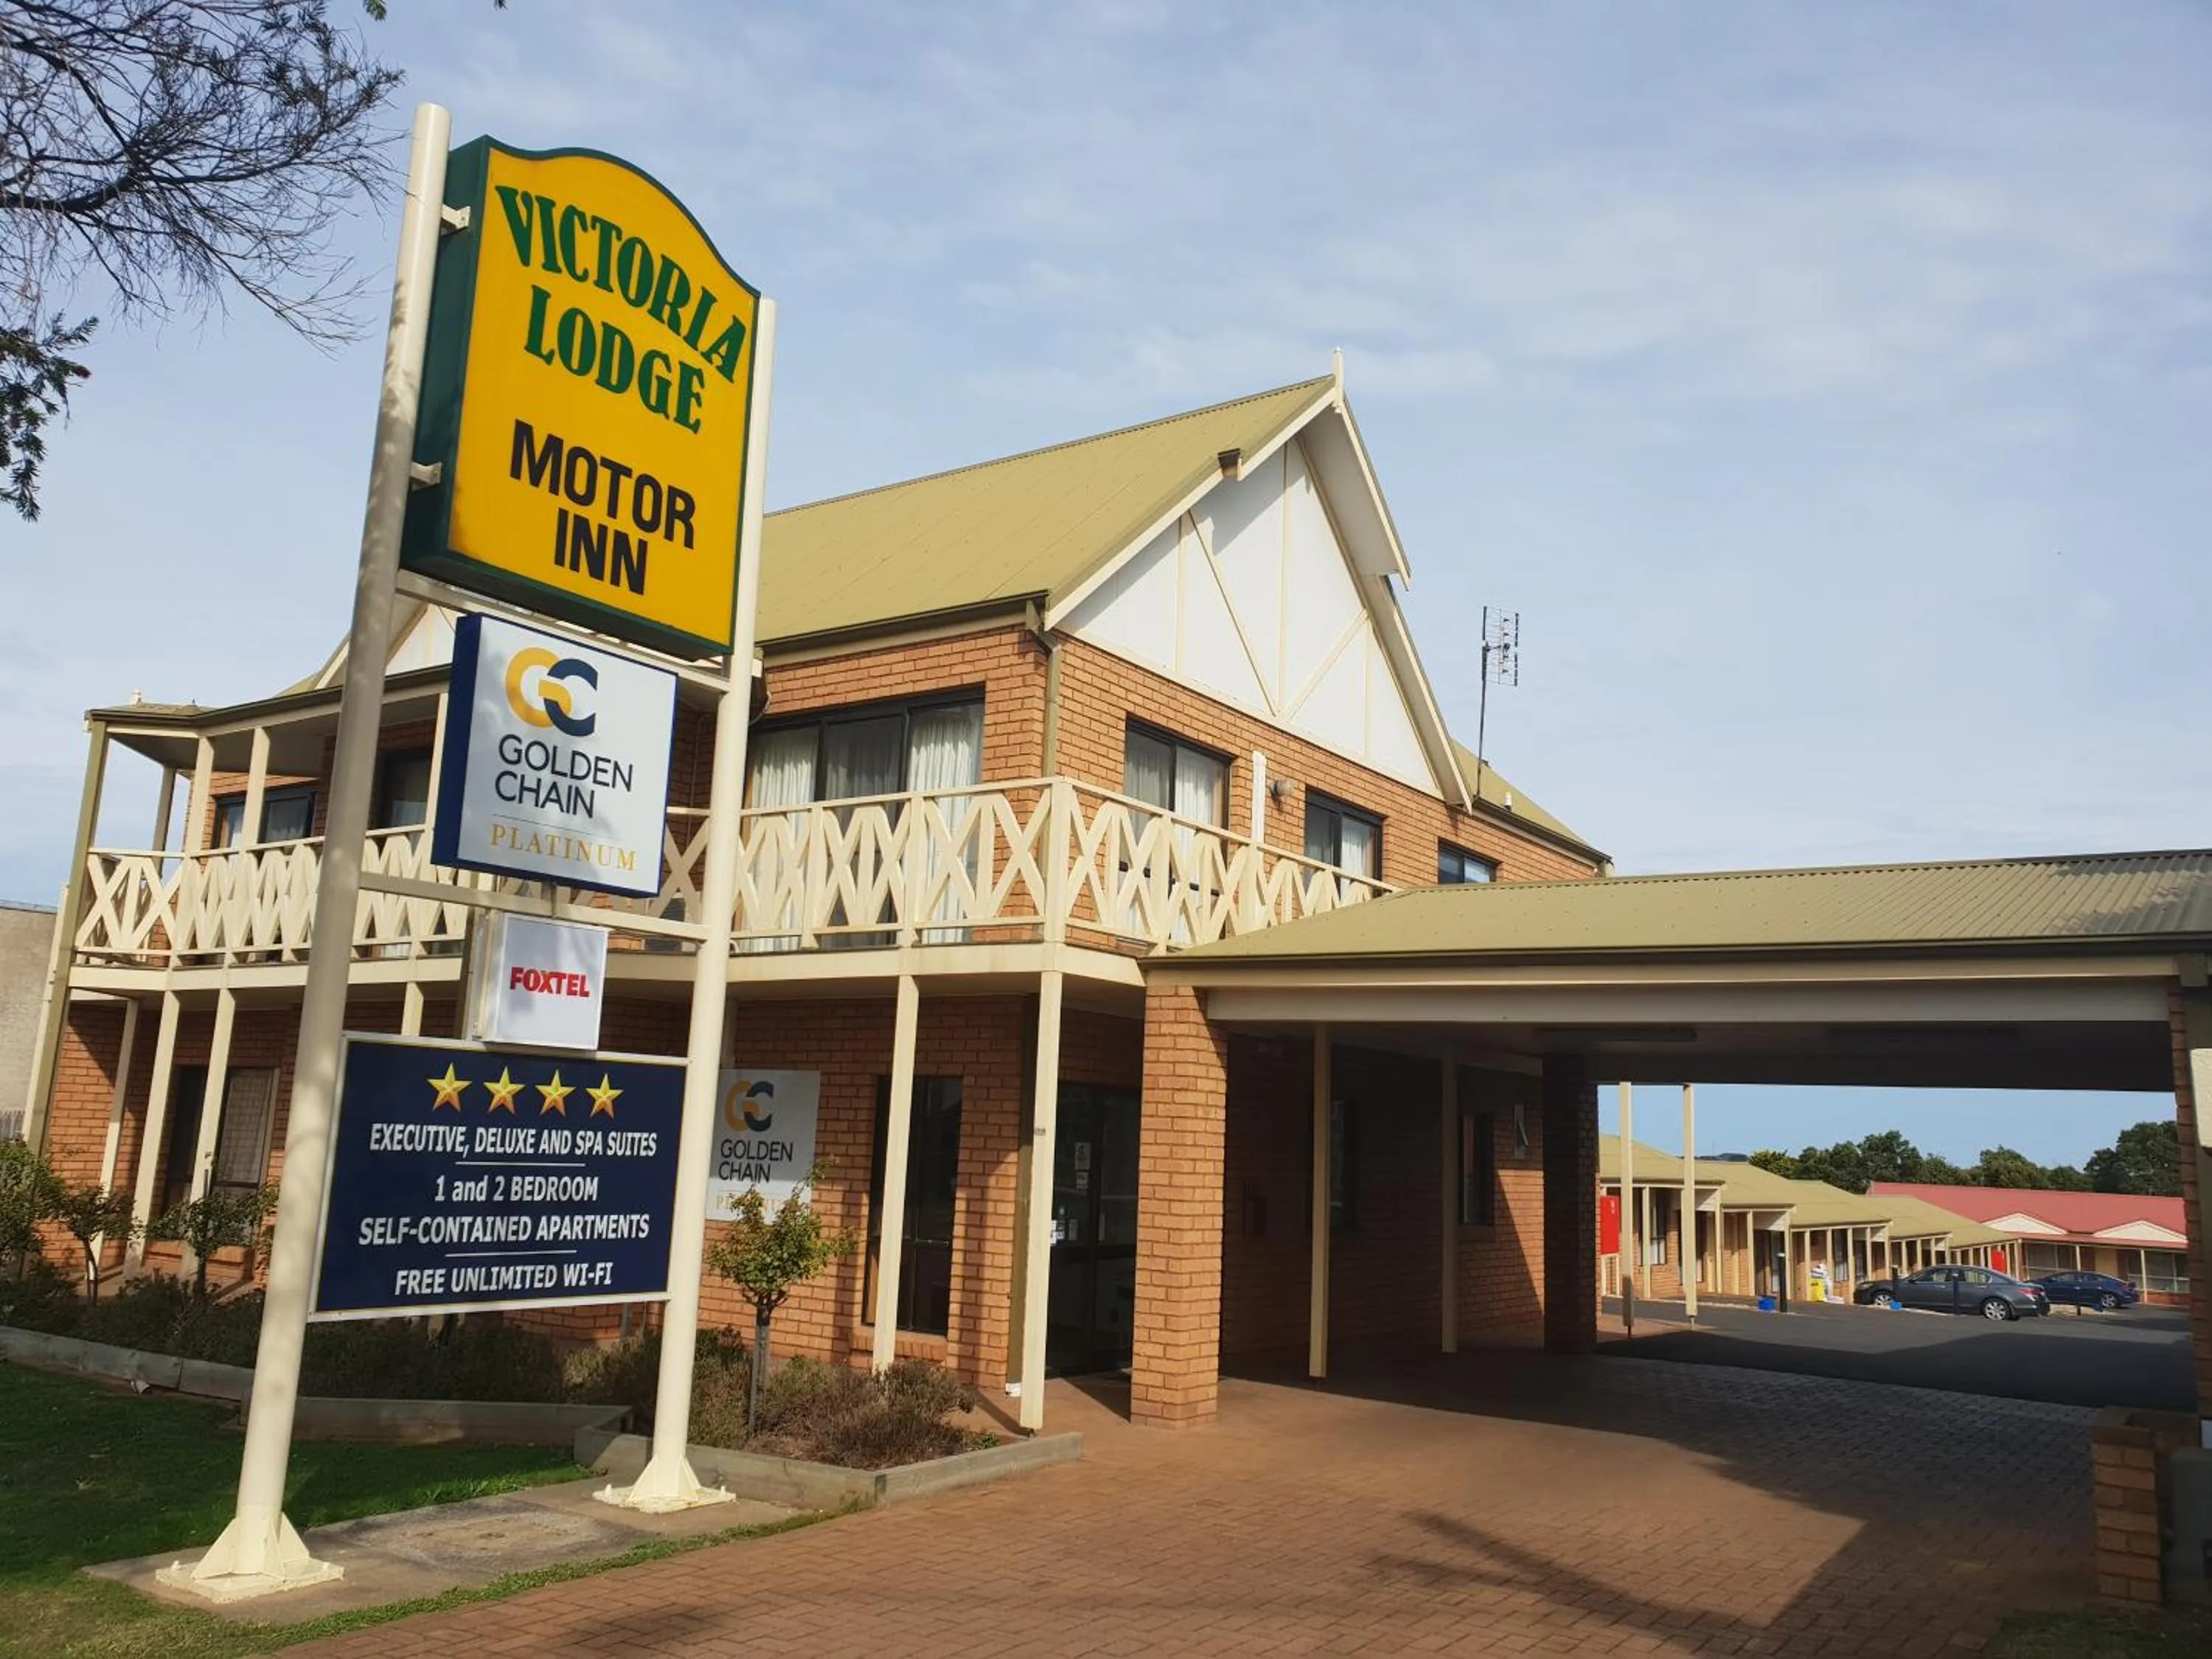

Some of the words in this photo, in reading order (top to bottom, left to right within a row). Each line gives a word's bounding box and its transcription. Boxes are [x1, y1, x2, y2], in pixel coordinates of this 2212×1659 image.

[495, 185, 746, 383] VICTORIA
[525, 285, 705, 434] LODGE
[509, 419, 695, 549] MOTOR
[554, 507, 648, 594] INN
[498, 734, 633, 791] GOLDEN
[495, 771, 594, 818] CHAIN
[490, 824, 636, 871] PLATINUM
[509, 967, 590, 998] FOXTEL
[370, 1123, 470, 1158] EXECUTIVE,
[474, 1127, 536, 1155] DELUXE
[539, 1130, 571, 1155] AND
[574, 1130, 603, 1155] SPA
[607, 1132, 657, 1157] SUITES
[720, 1139, 793, 1162] GOLDEN
[434, 1175, 445, 1202] 1
[452, 1175, 488, 1202] and
[493, 1176, 504, 1202] 2
[510, 1176, 599, 1202] BEDROOM
[718, 1161, 771, 1183] CHAIN
[358, 1215, 532, 1245] SELF-CONTAINED
[535, 1214, 650, 1242] APARTMENTS
[394, 1267, 446, 1295] FREE
[451, 1264, 557, 1293] UNLIMITED
[563, 1262, 613, 1287] WI-FI
